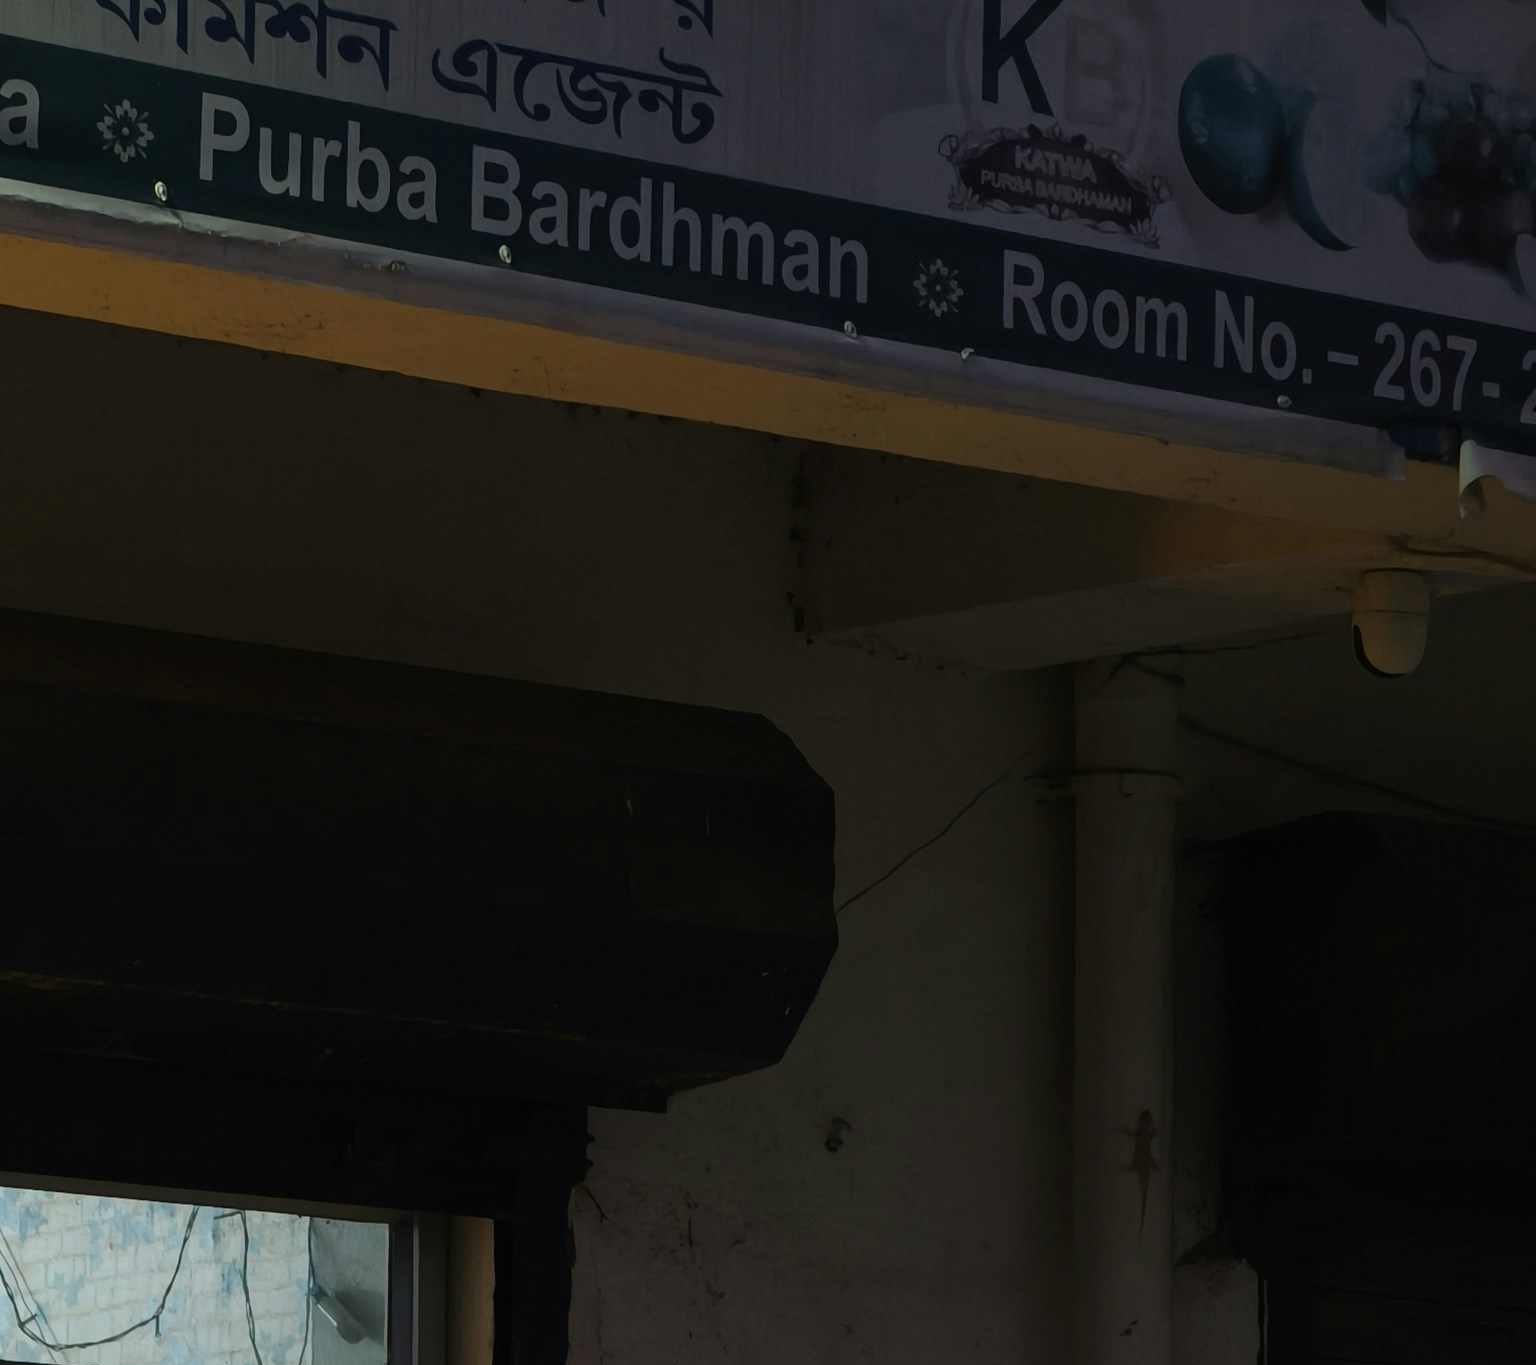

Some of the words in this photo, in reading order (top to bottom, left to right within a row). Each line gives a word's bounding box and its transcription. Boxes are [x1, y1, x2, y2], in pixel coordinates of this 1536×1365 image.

[431, 37, 723, 145] এজেন্ট
[1014, 144, 1098, 185] KATWA
[198, 91, 439, 225] Purba
[470, 145, 869, 304] Bardhman
[1002, 248, 1188, 363] Room
